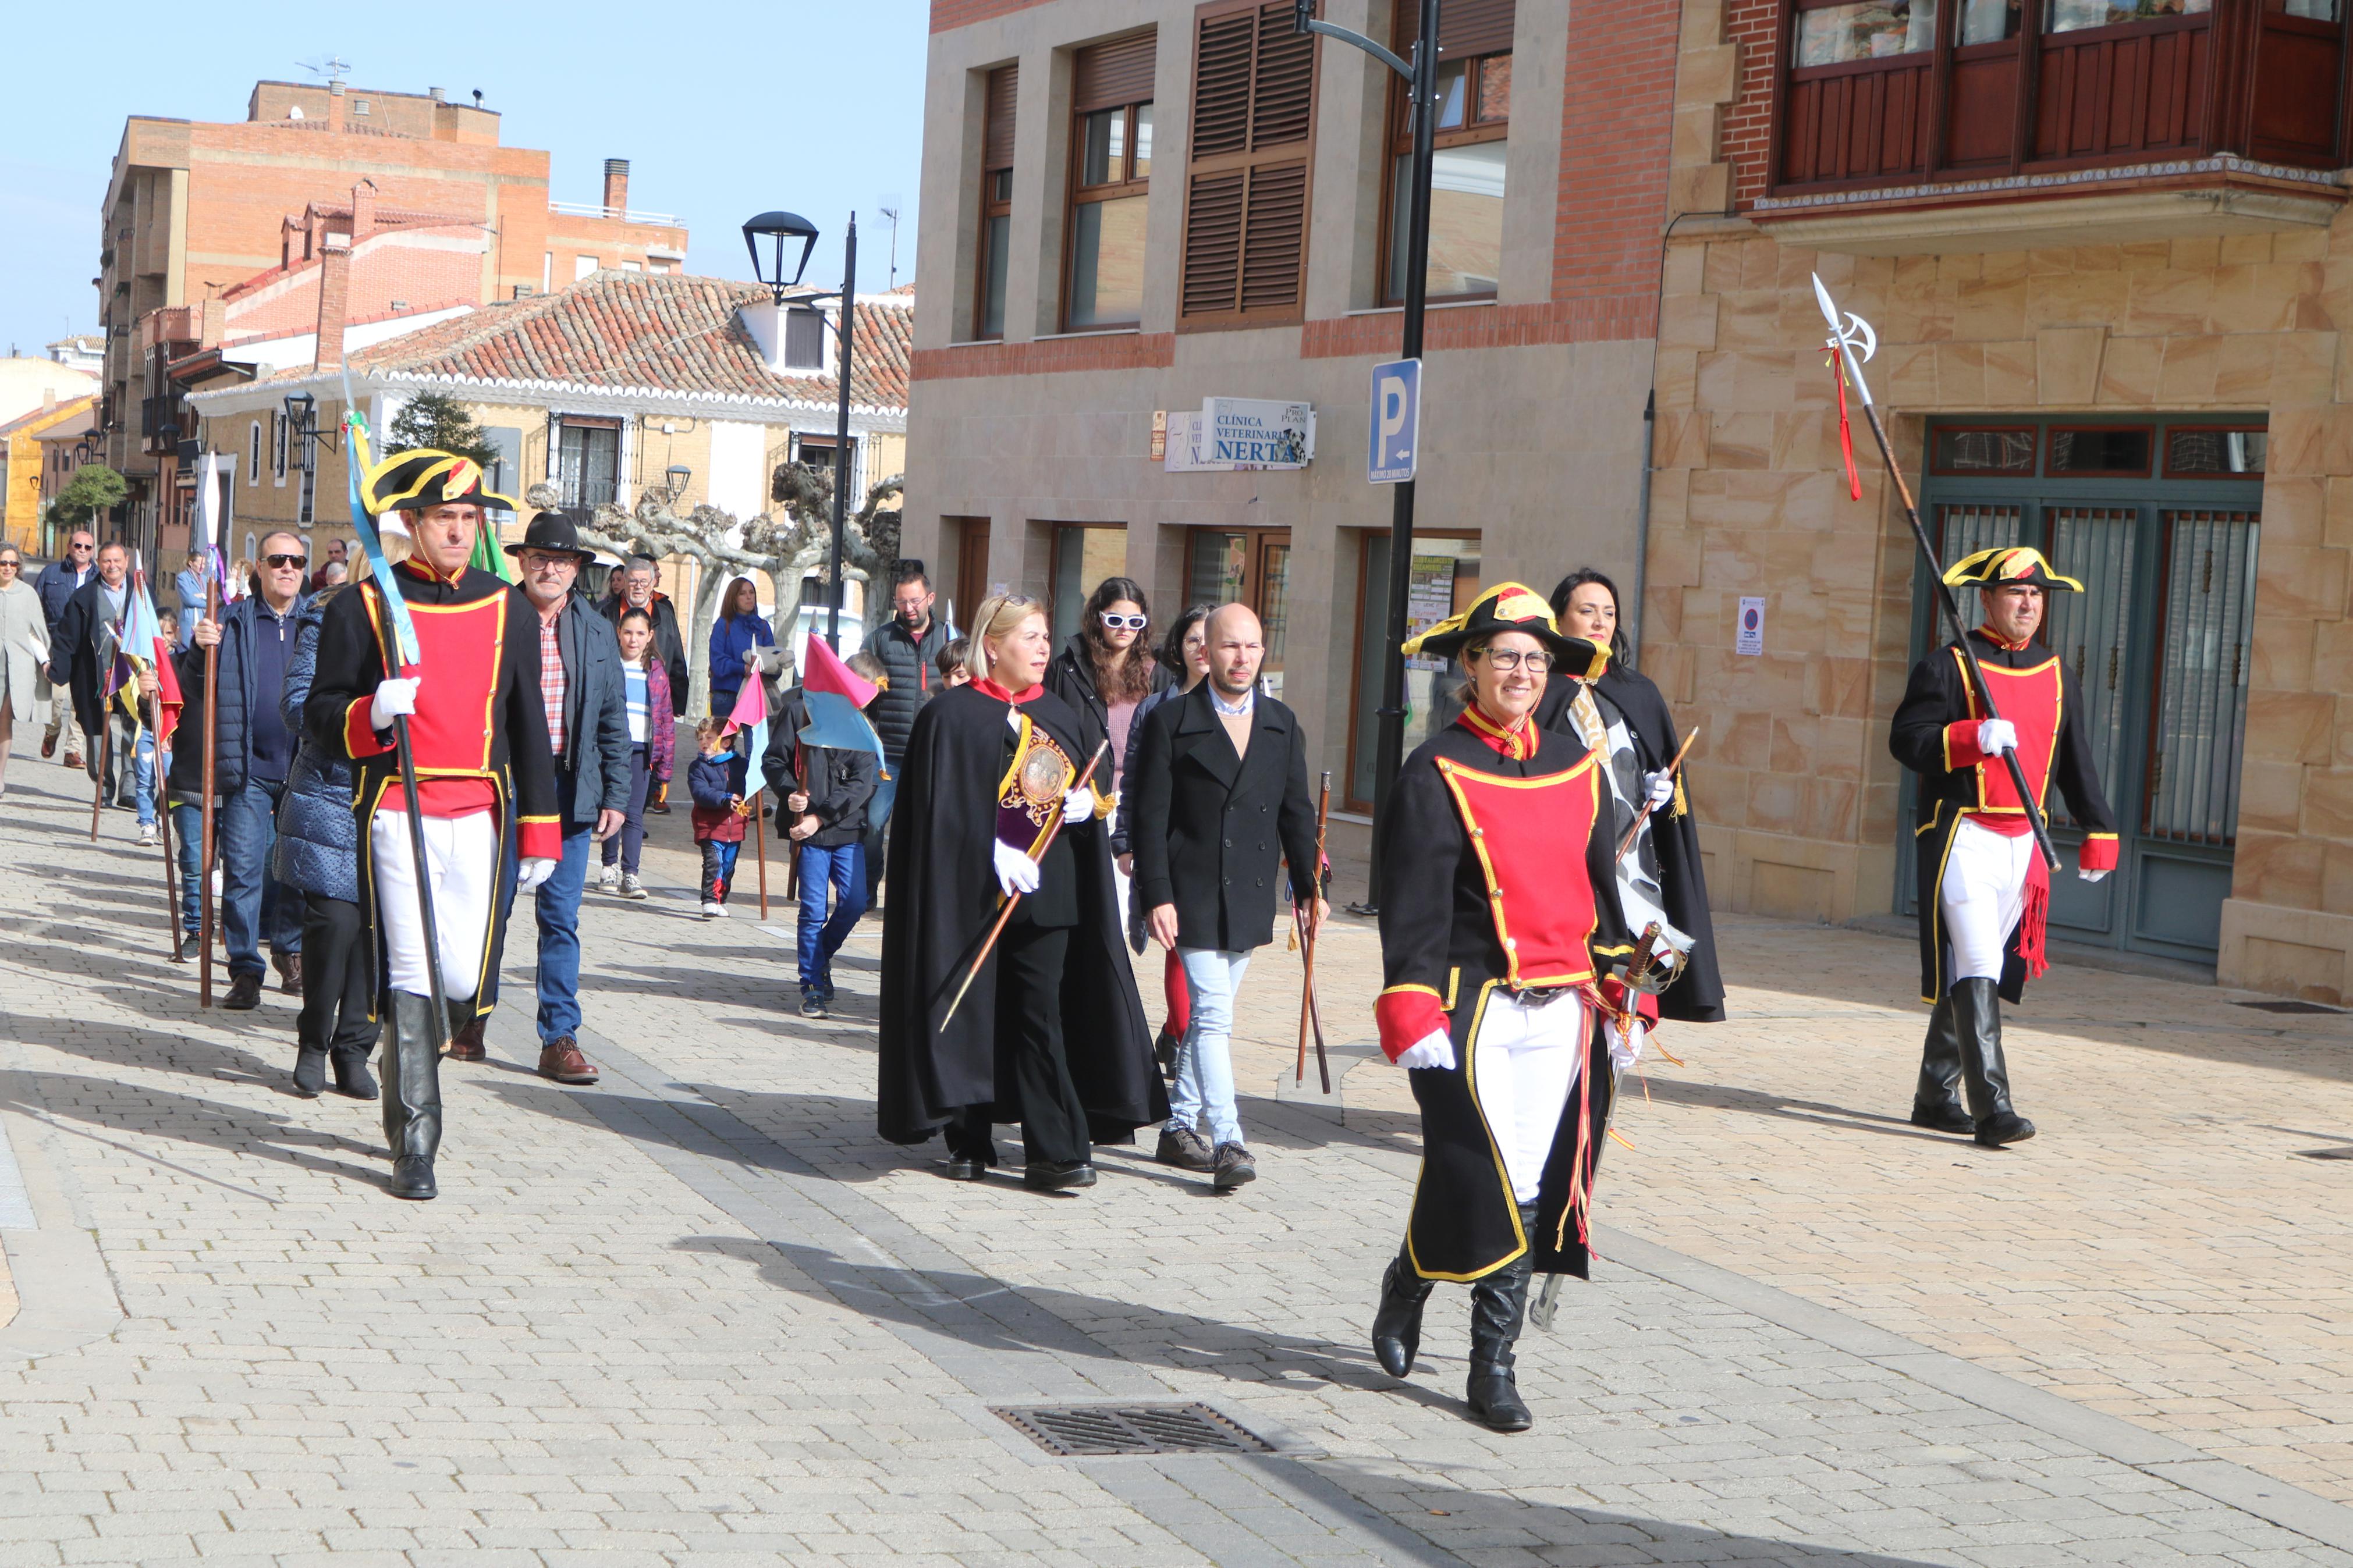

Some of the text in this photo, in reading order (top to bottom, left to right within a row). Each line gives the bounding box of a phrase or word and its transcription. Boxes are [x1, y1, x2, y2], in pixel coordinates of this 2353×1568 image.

[1218, 414, 1262, 427] CLÍNICA
[1377, 376, 1407, 468] P
[1215, 440, 1296, 463] NERTA
